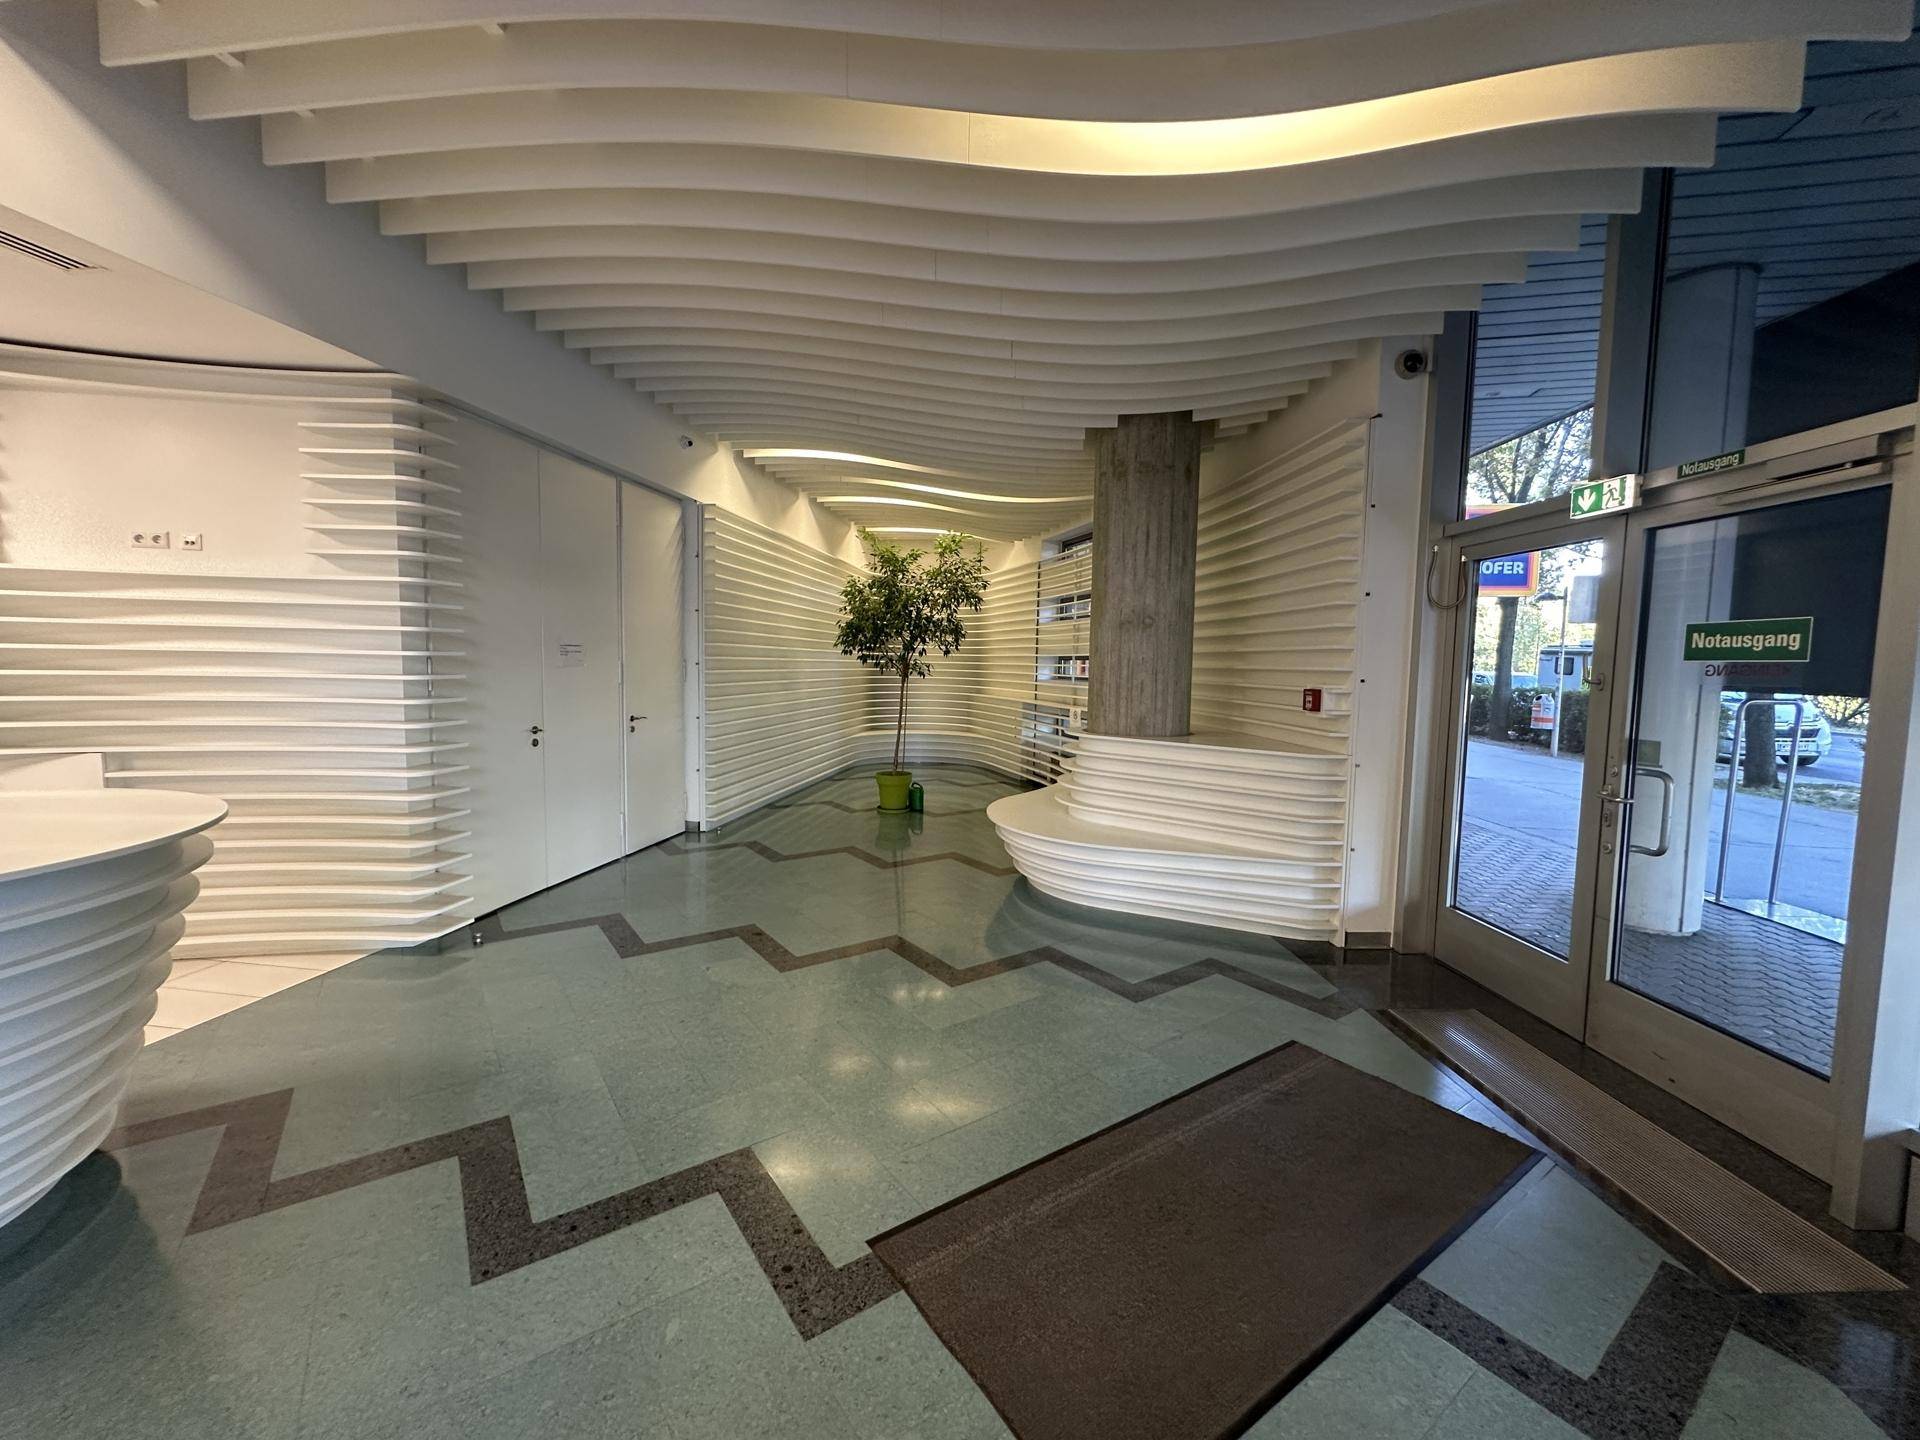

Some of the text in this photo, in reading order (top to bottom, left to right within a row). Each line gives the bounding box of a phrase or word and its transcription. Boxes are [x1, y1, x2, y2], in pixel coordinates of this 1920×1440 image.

[1681, 453, 1740, 476] Notausgang
[1480, 561, 1524, 575] OFER
[1691, 632, 1801, 651] Notausgang
